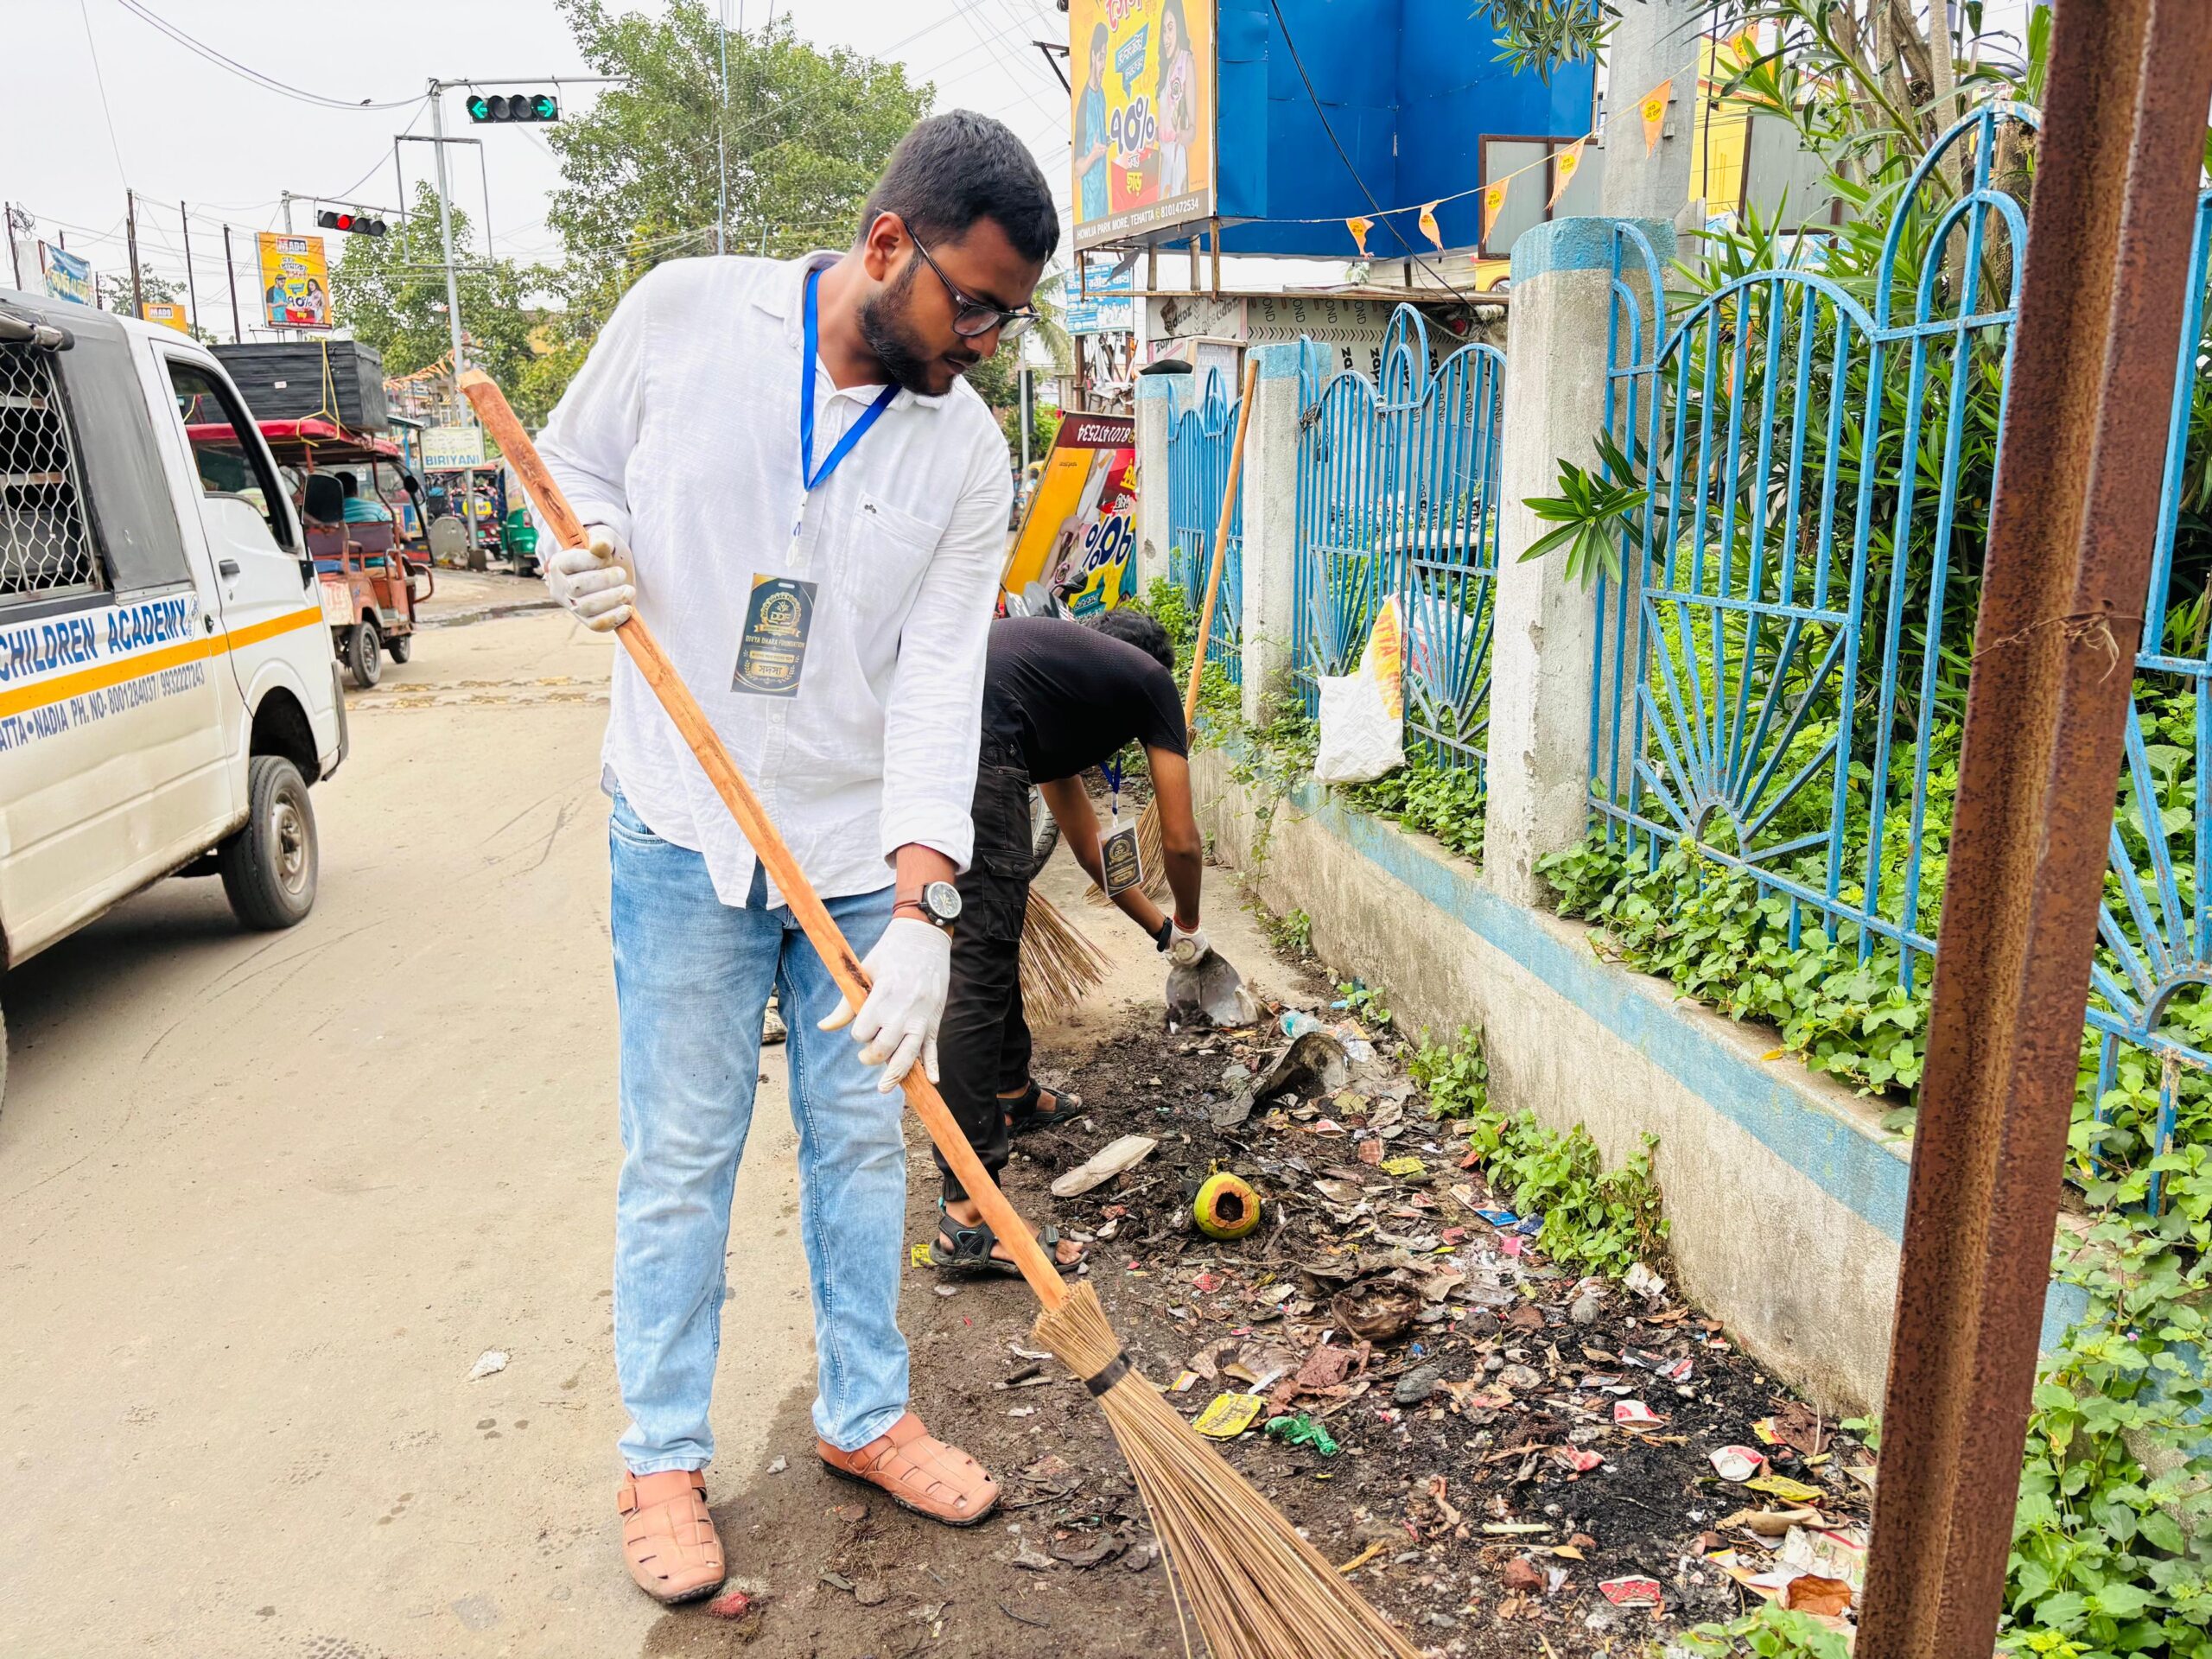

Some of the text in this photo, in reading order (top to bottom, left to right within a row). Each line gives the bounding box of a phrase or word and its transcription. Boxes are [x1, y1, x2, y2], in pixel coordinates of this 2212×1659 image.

[1097, 223, 1111, 236] PARK
[1130, 209, 1155, 226] TEHATTA
[1160, 198, 1199, 218] 8101472534
[1262, 297, 1275, 322] OND
[1293, 298, 1306, 323] OND
[1325, 299, 1338, 324] OND
[1354, 301, 1366, 325] OND
[1077, 423, 1131, 443] 8101472534
[425, 455, 480, 466] BIRIYANI
[0, 617, 99, 681] CHILDREN
[107, 598, 188, 654] ACADEMY
[761, 637, 778, 645] DHARA
[33, 703, 69, 740] NADIA
[70, 696, 90, 727] PH.
